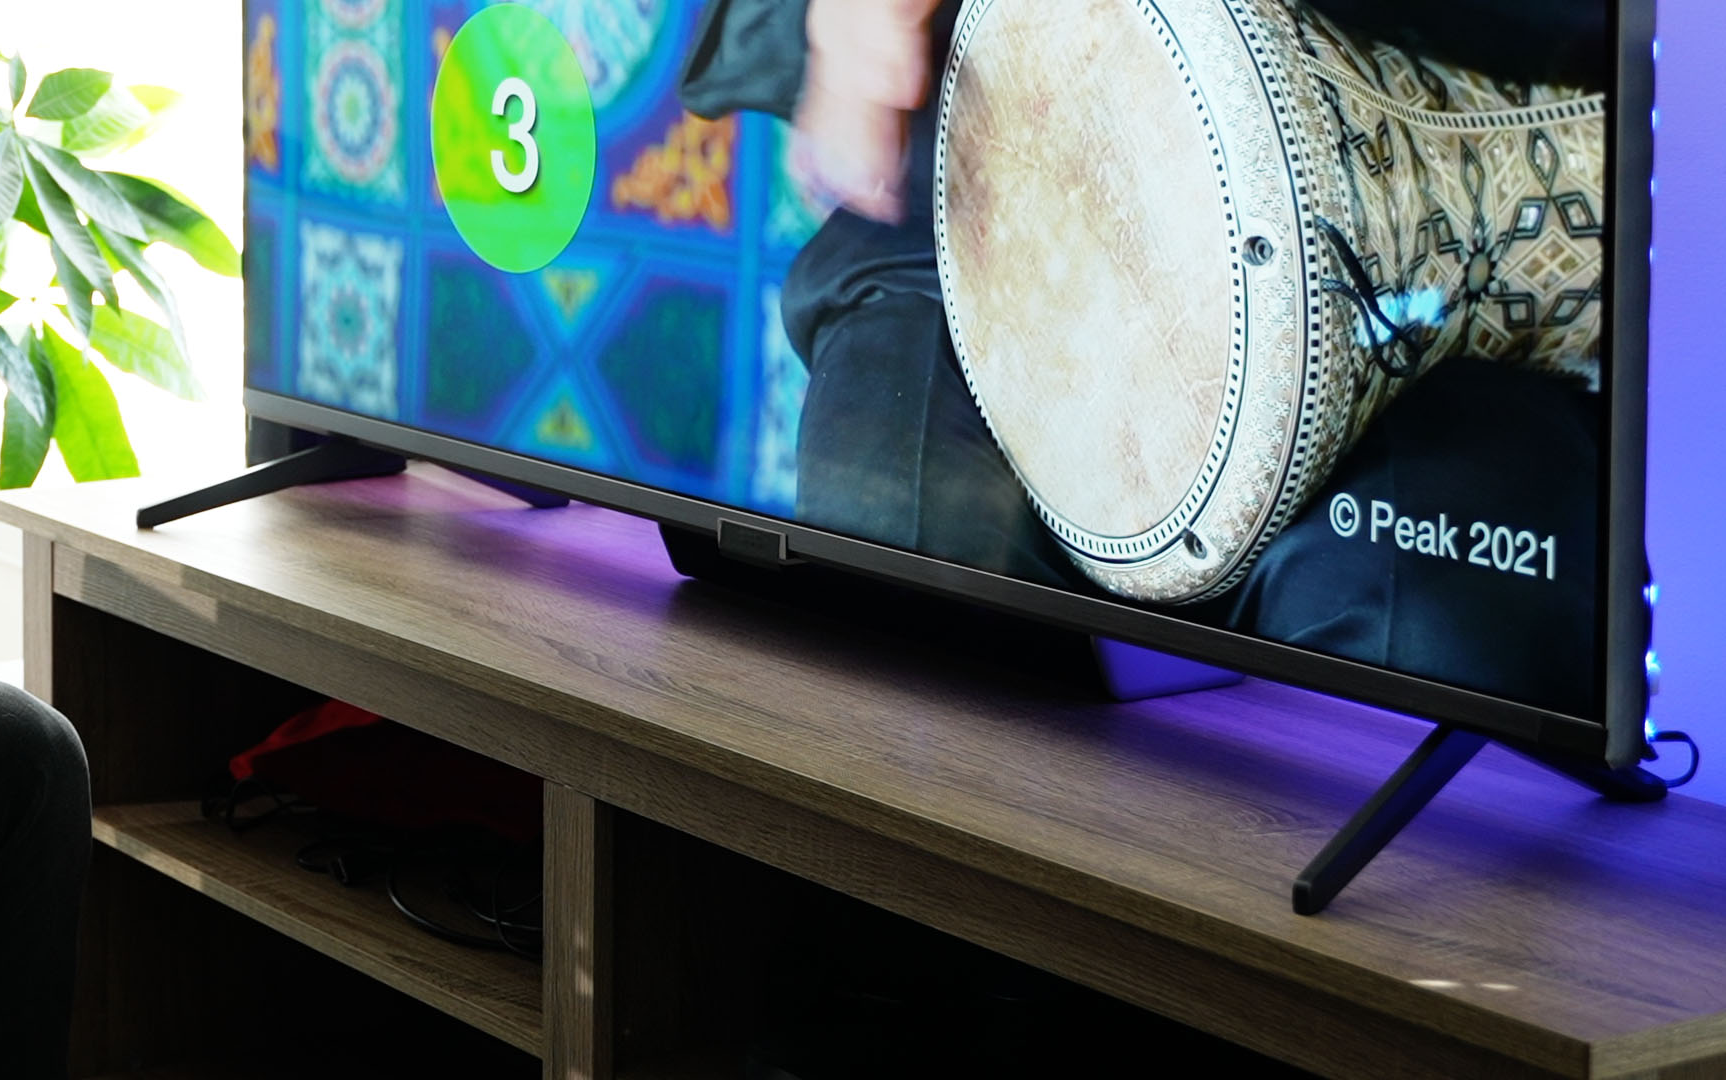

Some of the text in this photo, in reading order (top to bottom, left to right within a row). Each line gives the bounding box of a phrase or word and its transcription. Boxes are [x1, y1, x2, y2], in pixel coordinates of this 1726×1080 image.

[490, 77, 540, 193] 3
[1370, 499, 1459, 560] Peak
[1468, 522, 1556, 580] 2021
